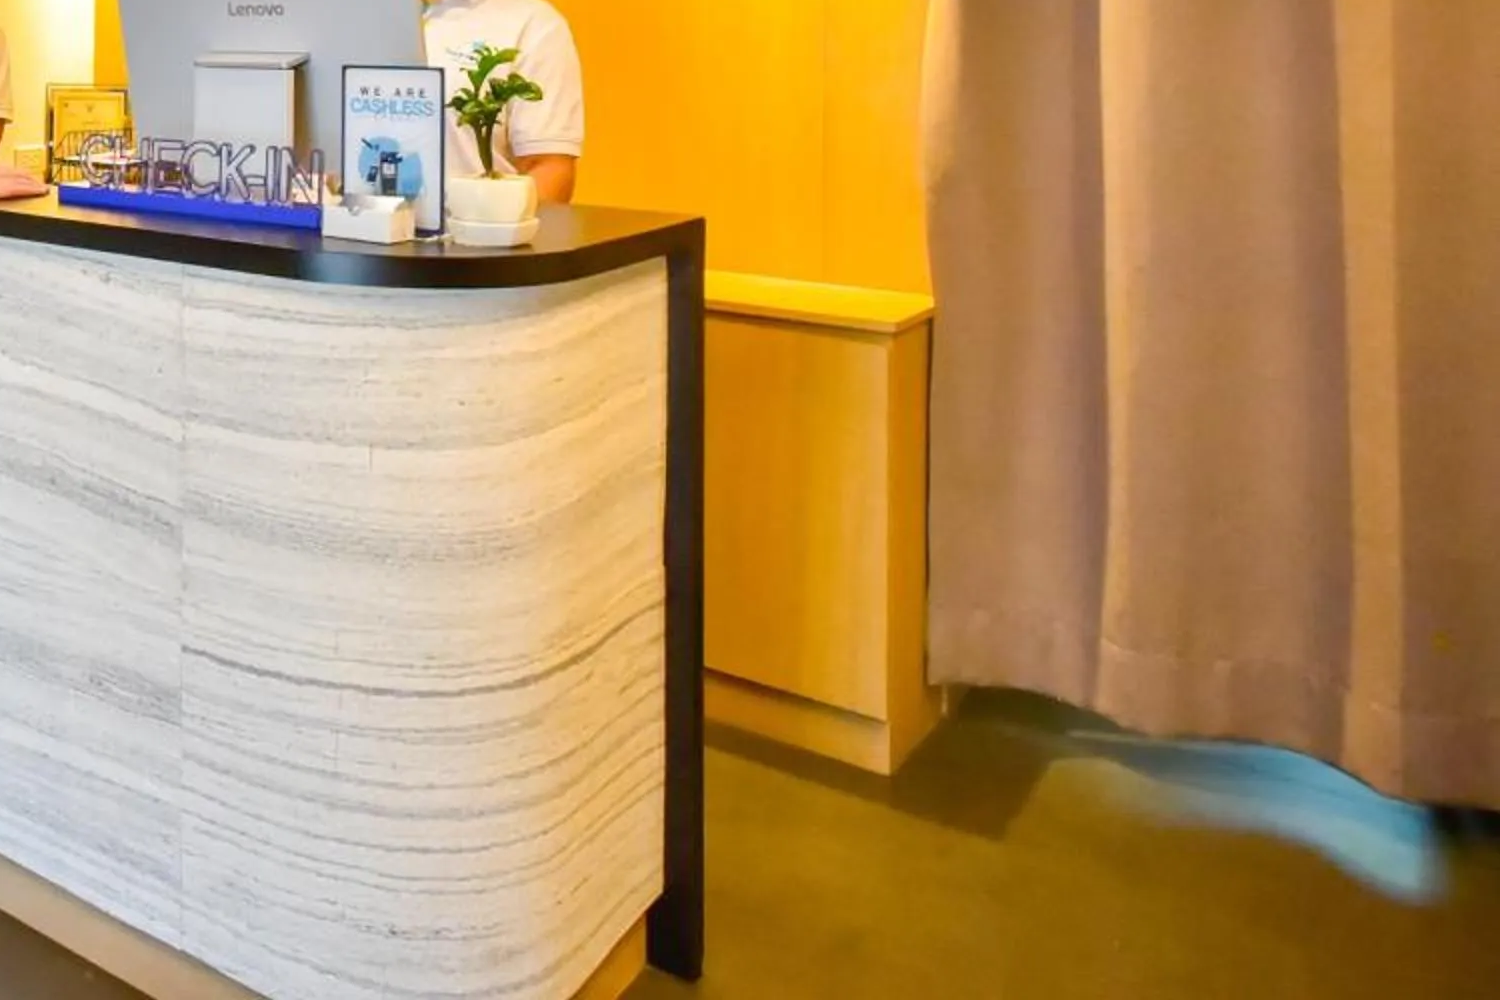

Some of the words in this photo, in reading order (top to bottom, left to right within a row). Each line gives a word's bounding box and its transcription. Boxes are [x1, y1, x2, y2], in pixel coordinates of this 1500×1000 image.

[227, 1, 285, 17] Lenovo
[359, 86, 382, 97] WE
[394, 87, 427, 99] ARE
[350, 98, 435, 117] CASHLESS
[80, 132, 325, 205] CHECK-IN
